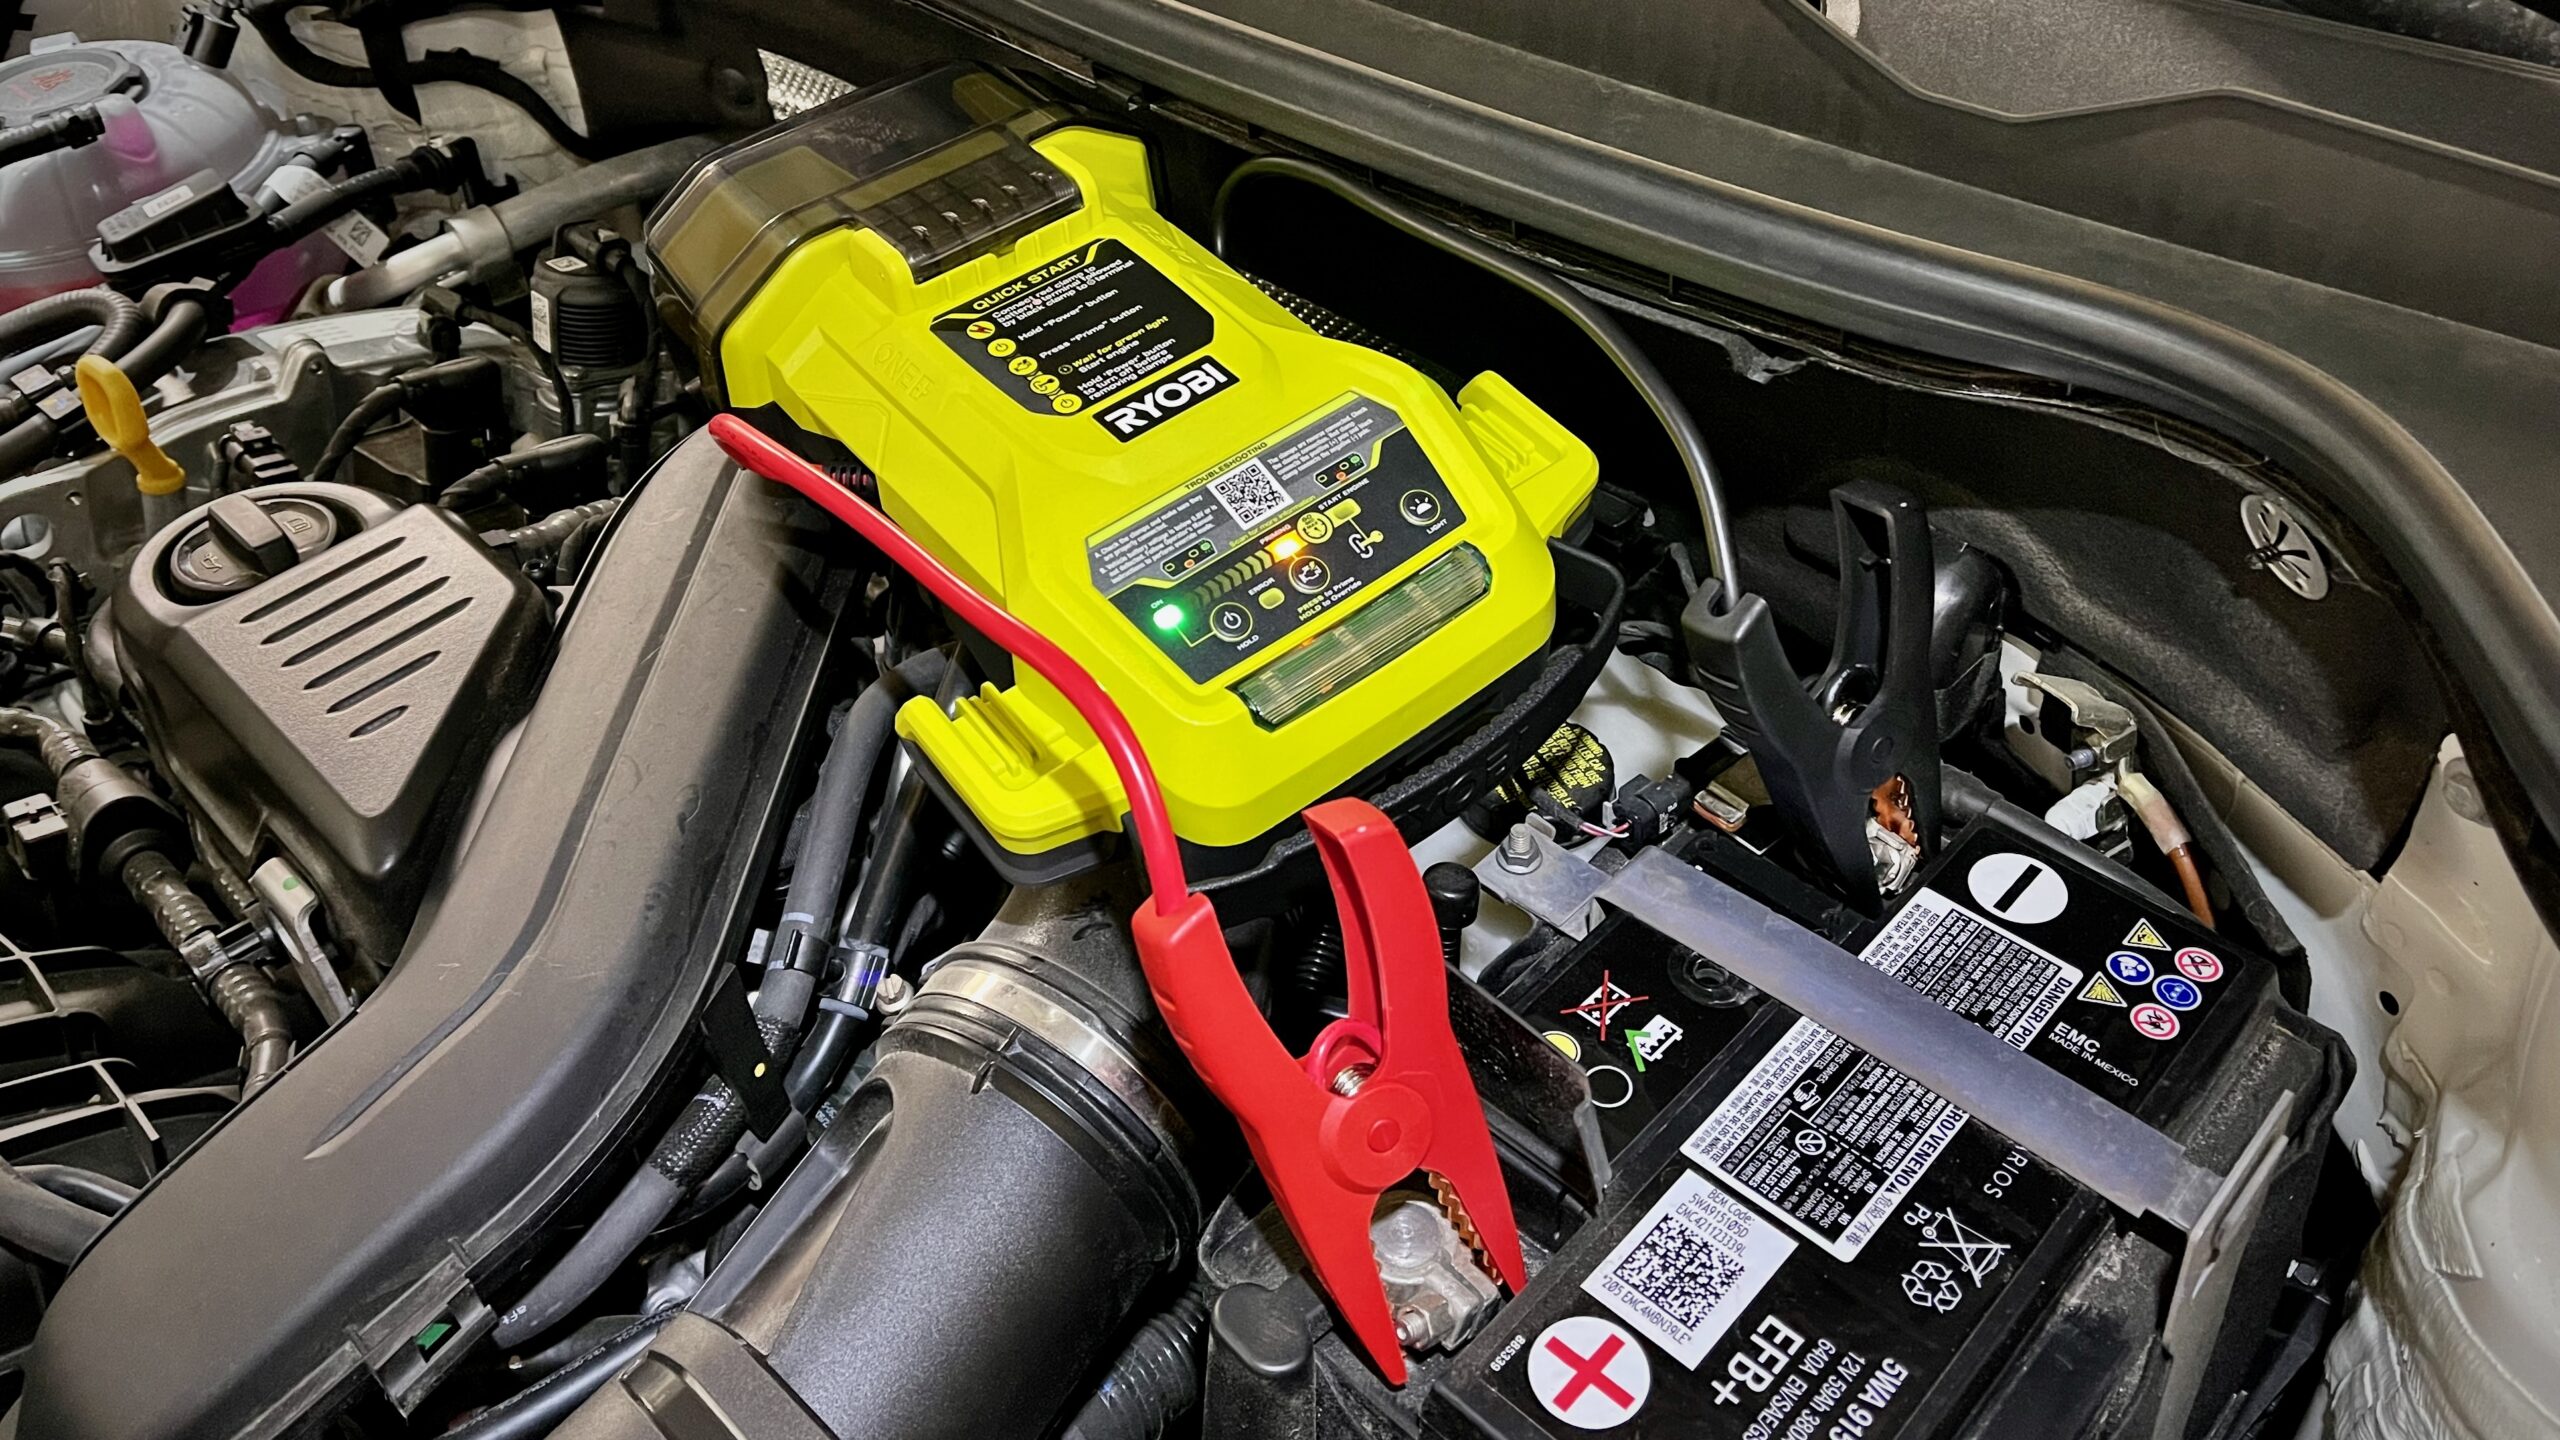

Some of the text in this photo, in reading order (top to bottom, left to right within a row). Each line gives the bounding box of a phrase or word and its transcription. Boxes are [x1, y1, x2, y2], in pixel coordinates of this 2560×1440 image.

[970, 254, 1083, 311] QUICK START
[990, 265, 1097, 318] Connect red clamp to
[995, 258, 1124, 323] battery terminal followed
[1000, 259, 1135, 328] by black clamp to terminal
[1016, 325, 1044, 340] Hold
[1083, 287, 1120, 307] button
[1037, 340, 1072, 358] Press
[1108, 304, 1144, 323] button
[1070, 315, 1170, 367] Wait for green light
[1076, 339, 1142, 373] Start engine
[1075, 375, 1104, 391] Hold
[1140, 337, 1178, 357] button
[1081, 348, 1170, 395] to turn off before
[1086, 353, 1176, 400] removing clamps
[1104, 362, 1228, 434] RYOBI
[1184, 441, 1268, 490] TROUBLESHOOTING
[1316, 477, 1370, 510] START ENGINE
[1228, 495, 1318, 547] Scan for more information
[1257, 523, 1293, 545] PRIMING
[1424, 518, 1450, 534] LIGHT
[1148, 598, 1165, 609] ON
[1246, 576, 1277, 595] ERROR
[1295, 576, 1356, 613] PRESS to Prime
[1297, 580, 1364, 620] HOLD to Override
[1234, 634, 1261, 651] HOLD
[1584, 768, 1603, 785] USE
[1587, 757, 1607, 774] CAP
[1900, 941, 1914, 953] THE
[1810, 1037, 1826, 1051] NOT
[2053, 1019, 2102, 1055] EMC
[1797, 1048, 1816, 1065] OPEN
[2047, 1031, 2140, 1088] MADE IN MEXICO
[1869, 1075, 1891, 1095] AGUA.
[1698, 1078, 1775, 1159] DEL ALCANCE DE LOS NIÑOS.
[1728, 1090, 1778, 1142] TENIR HORS DE LA
[1905, 1105, 1925, 1124] FAST.
[1737, 1126, 1792, 1182] DÉFENSE DE FUMER
[1891, 1129, 1905, 1141] SE
[1899, 1130, 1920, 1149] WITH
[1747, 1144, 1788, 1188] LES FLAMMES
[1757, 1148, 1802, 1194] ÉTINCELLES ET
[1766, 1164, 1803, 1201] ÉVITER LES
[1826, 1151, 1856, 1181] SMOKING
[1836, 1161, 1862, 1188] FLAMES
[1846, 1168, 1872, 1194] SPARKS
[1983, 1144, 2029, 1200] RIOS
[1794, 1187, 1825, 1219] CIGARROS
[1862, 1180, 1877, 1194] NO
[1688, 1190, 1750, 1241] 5WA915105D
[1706, 1188, 1756, 1227] BEM Code:
[1808, 1193, 1835, 1220] FLAMAS
[1818, 1200, 1845, 1228] CHISPAS
[1836, 1211, 1851, 1226] NO
[1901, 1200, 1932, 1231] Pb
[1675, 1200, 1748, 1260] EMC421123339L
[1488, 1332, 1526, 1373] 885339
[1711, 1313, 1806, 1405] EFB+
[1796, 1336, 1838, 1378] 640A
[1833, 1348, 1868, 1382] 12V
[1807, 1373, 1849, 1415] 59Ah
[1853, 1354, 1911, 1412] 5WA
